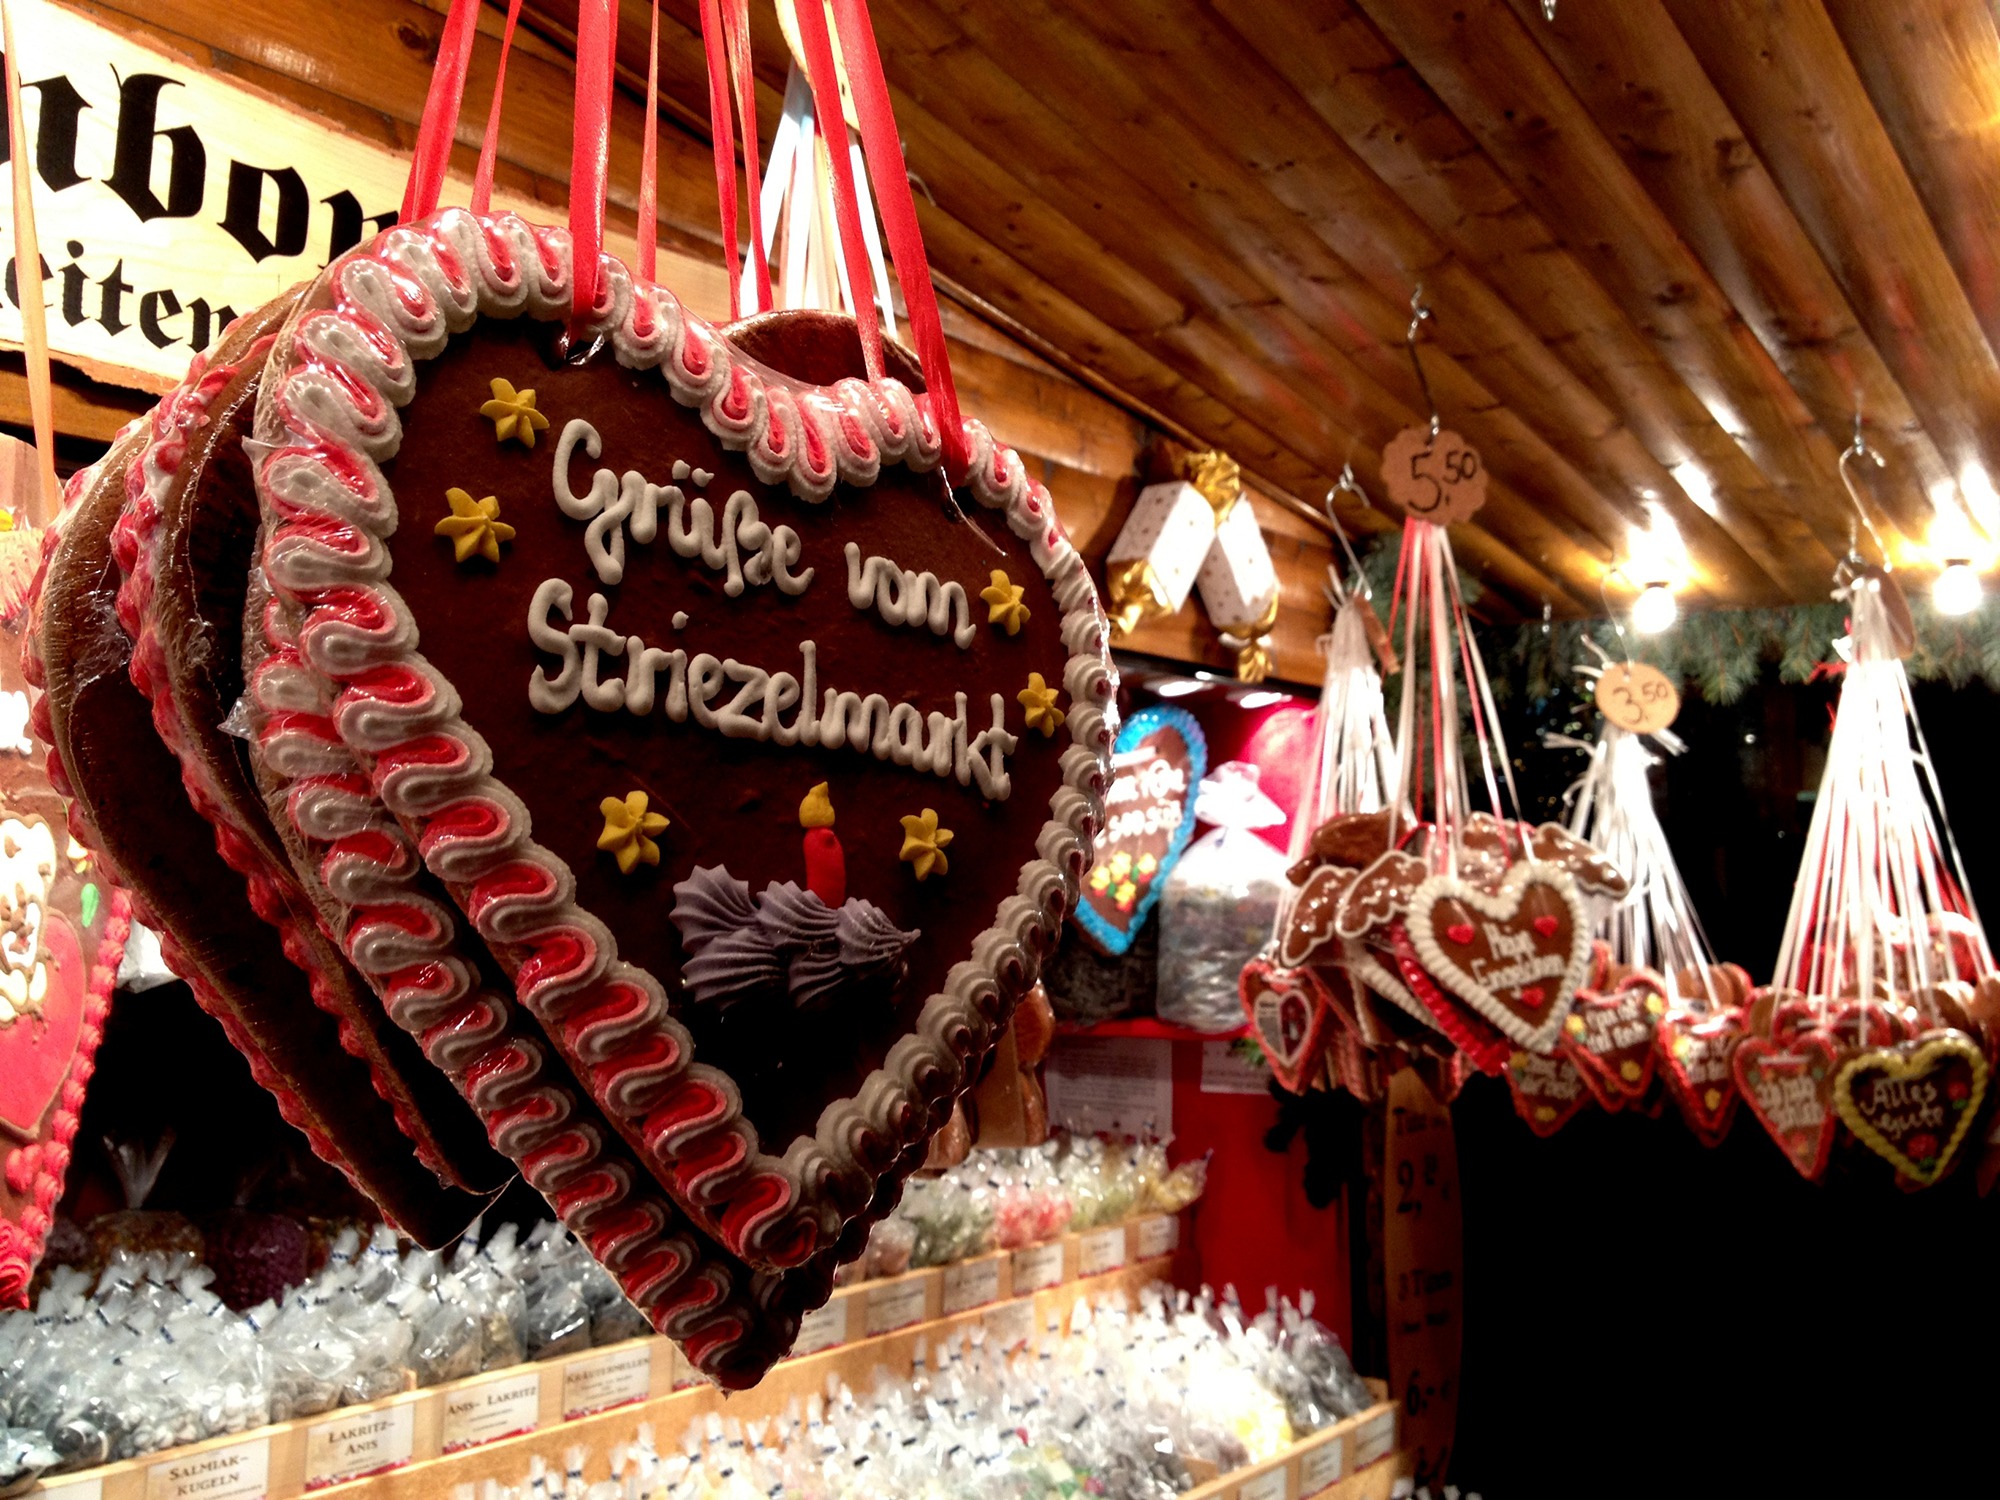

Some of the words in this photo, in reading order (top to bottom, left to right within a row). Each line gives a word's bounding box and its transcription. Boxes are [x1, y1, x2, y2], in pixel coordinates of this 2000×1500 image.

[553, 418, 814, 597] Grüße
[528, 578, 1019, 800] Striezelmarkt
[487, 1386, 537, 1406] LAKRITZ
[328, 1420, 395, 1444] LAKRITZ-
[345, 1440, 378, 1456] ANIS
[168, 1455, 249, 1481] SALMIAK-
[177, 1472, 240, 1496] KUGELN
